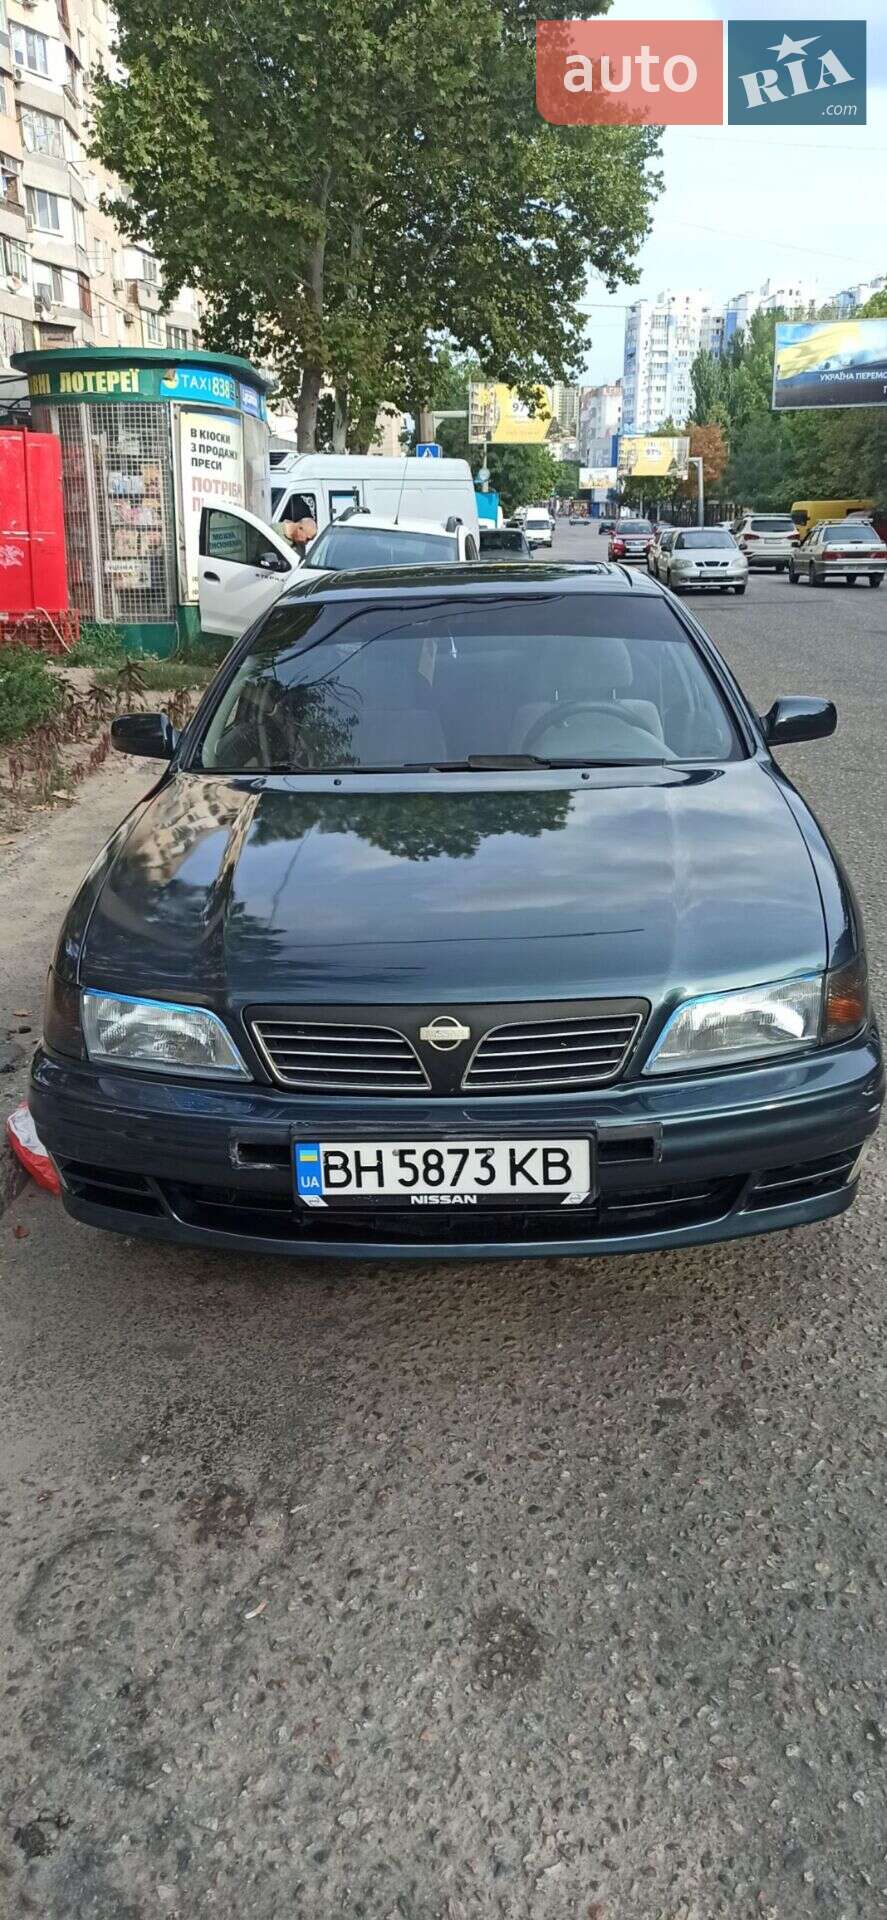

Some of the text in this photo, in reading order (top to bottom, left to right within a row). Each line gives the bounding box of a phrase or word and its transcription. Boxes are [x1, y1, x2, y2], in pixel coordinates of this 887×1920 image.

[60, 368, 140, 393] ЛОТЕРЕЇ
[181, 374, 211, 391] TAXI
[820, 371, 854, 381] УКРАЇНА
[190, 428, 231, 444] В КІОСКИ
[191, 457, 222, 470] ПРЕСИ
[323, 1147, 572, 1188] BH 5873 KB
[301, 1177, 320, 1187] UA
[411, 1194, 478, 1205] NISSAN
